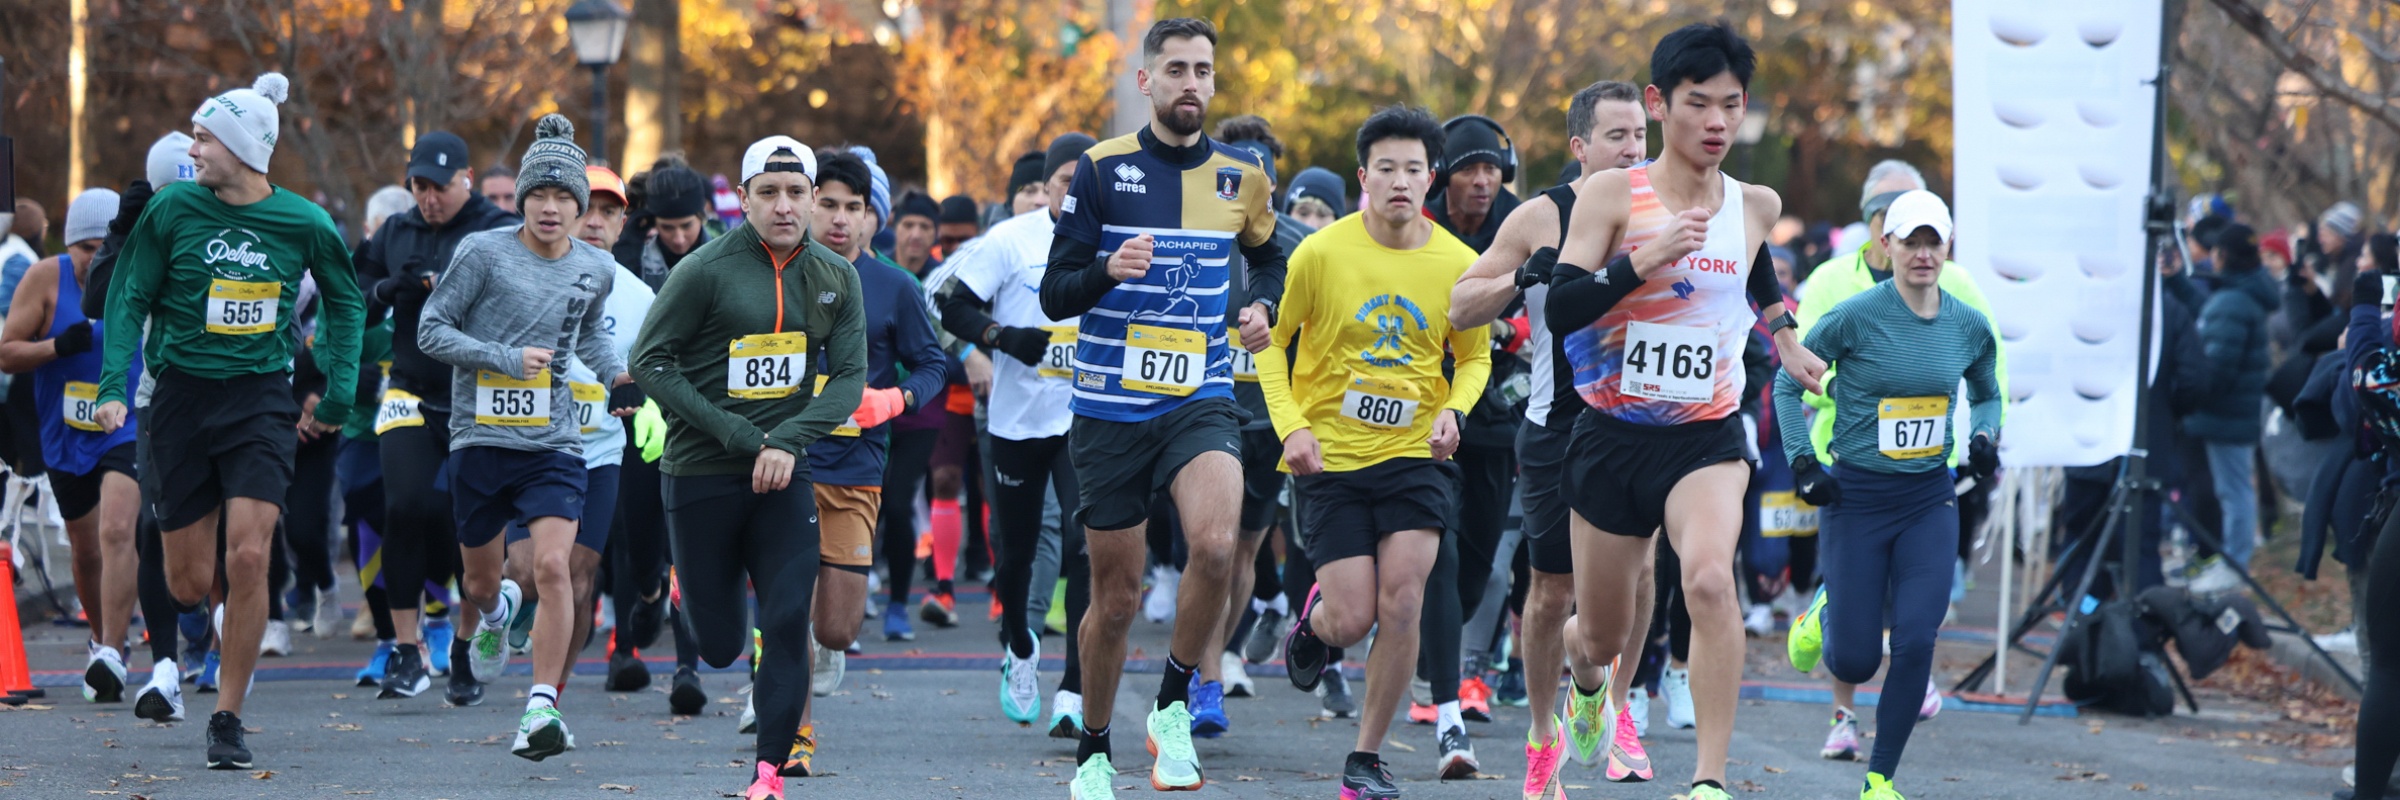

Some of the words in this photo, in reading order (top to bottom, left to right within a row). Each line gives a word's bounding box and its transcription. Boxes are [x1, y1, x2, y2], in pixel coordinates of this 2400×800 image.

[204, 239, 271, 271] Pelham
[1686, 255, 1738, 275] YORK
[222, 301, 264, 325] 555
[745, 356, 792, 388] 834
[1140, 350, 1189, 384] 670
[1626, 340, 1713, 380] 4163
[491, 389, 535, 416] 553
[1357, 395, 1404, 425] 860
[1895, 419, 1935, 448] 677
